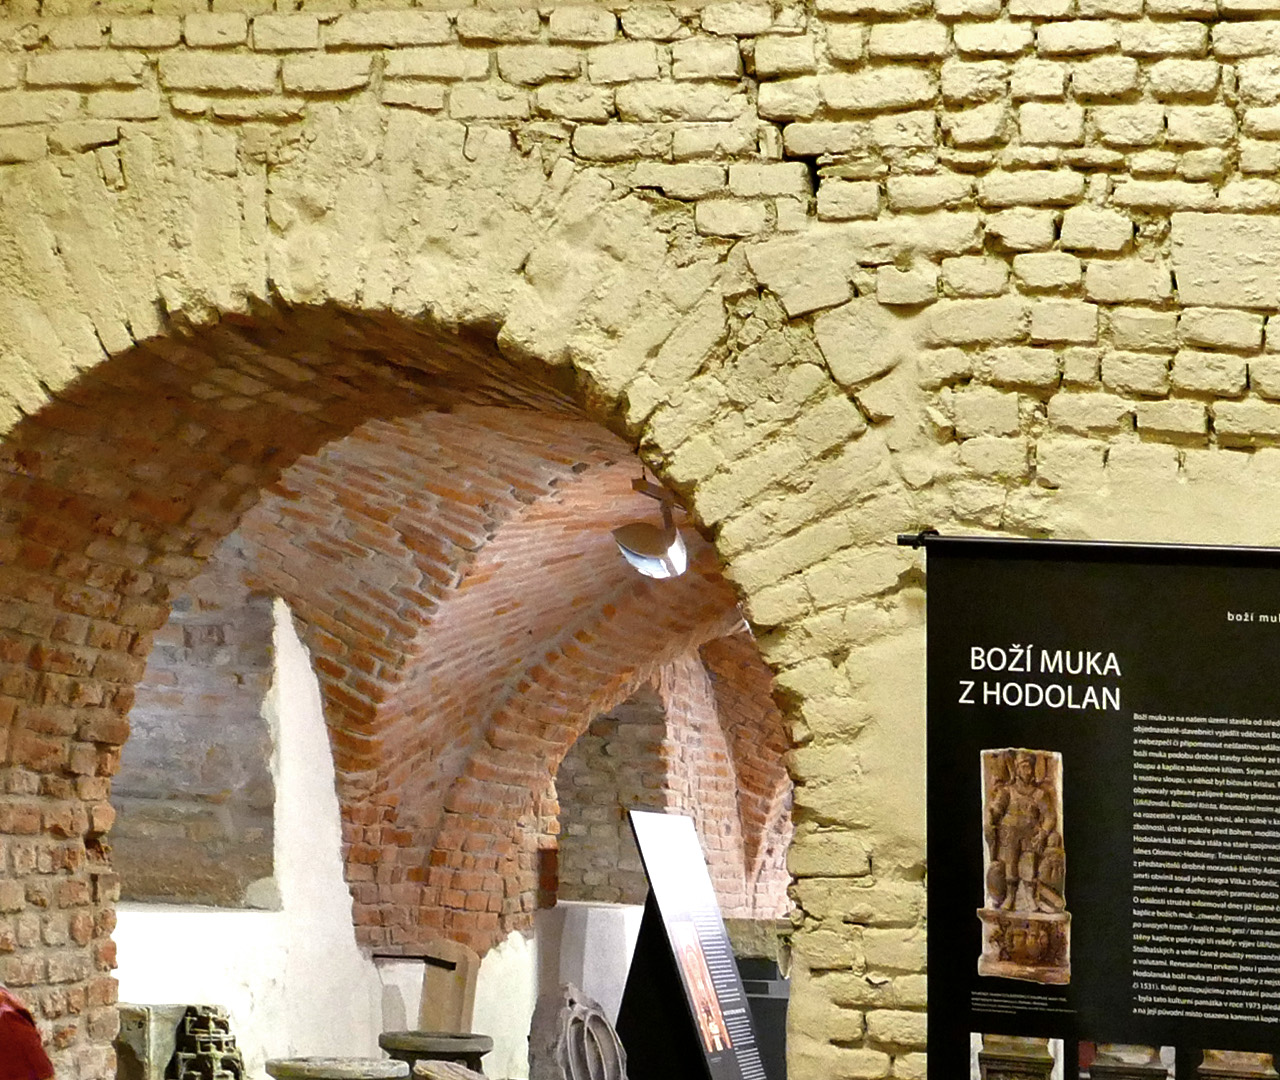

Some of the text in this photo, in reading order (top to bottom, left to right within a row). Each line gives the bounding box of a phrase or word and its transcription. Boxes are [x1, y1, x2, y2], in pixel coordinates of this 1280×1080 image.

[1227, 611, 1254, 622] boží
[970, 643, 1122, 677] BOŽÍ MUKA
[958, 680, 1121, 711] Z HODOLAN
